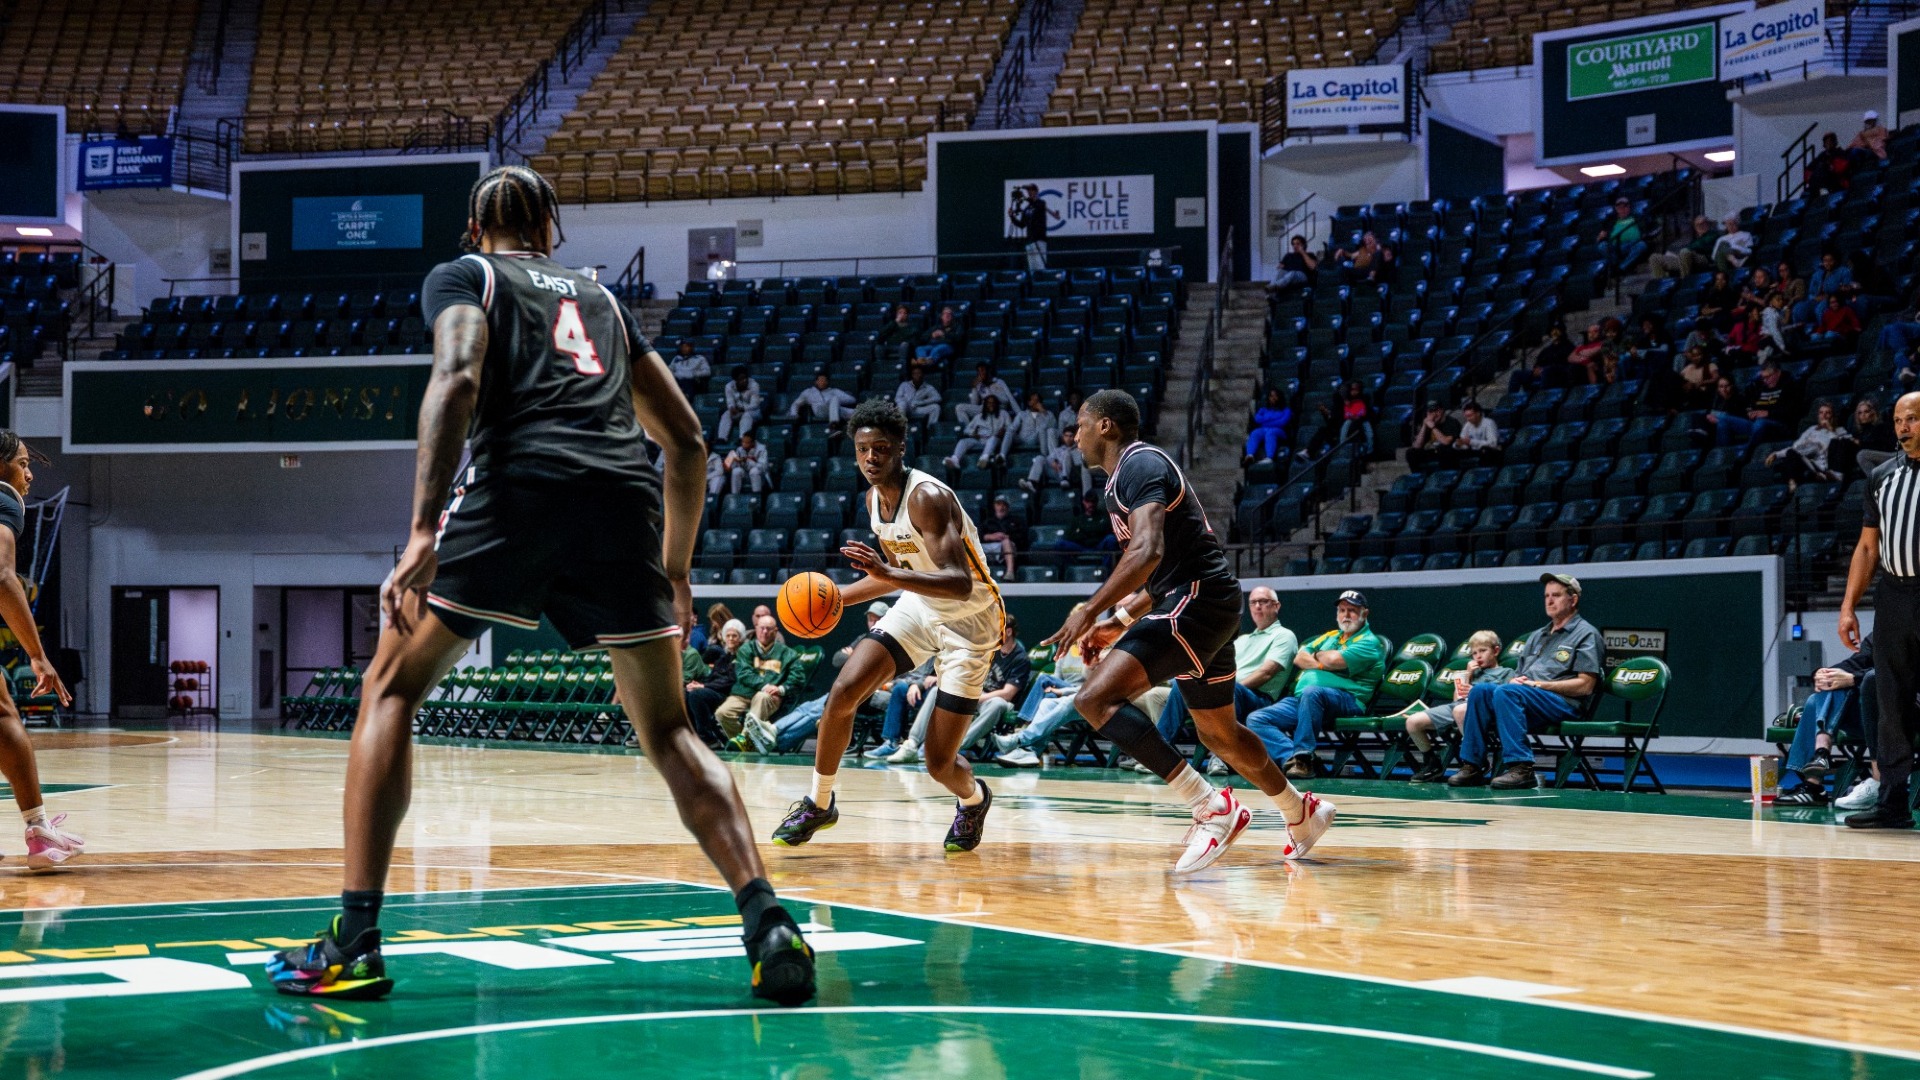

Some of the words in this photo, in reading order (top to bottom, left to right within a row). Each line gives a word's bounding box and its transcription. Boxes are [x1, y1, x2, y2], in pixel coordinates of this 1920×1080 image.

[1724, 30, 1747, 49] La
[1751, 7, 1820, 41] Capitol
[1576, 33, 1700, 66] COURTYARD
[1723, 54, 1760, 66] FEDERAL
[1762, 45, 1791, 57] CREDIT
[1793, 37, 1820, 48] UNION
[1608, 55, 1672, 80] Marriott
[1292, 82, 1318, 99] La
[1323, 77, 1399, 101] Capitol
[1292, 107, 1332, 115] FEDERAL
[1335, 105, 1367, 113] CREDIT
[117, 146, 143, 155] FIRST
[116, 165, 141, 174] BANK
[1067, 180, 1129, 199] FULL
[337, 221, 376, 230] CARPET
[1088, 219, 1129, 231] TITLE
[346, 230, 368, 240] ONE
[526, 269, 578, 296] EAST
[552, 298, 606, 377] 4
[1606, 636, 1629, 648] TOP
[1638, 636, 1662, 649] CAT
